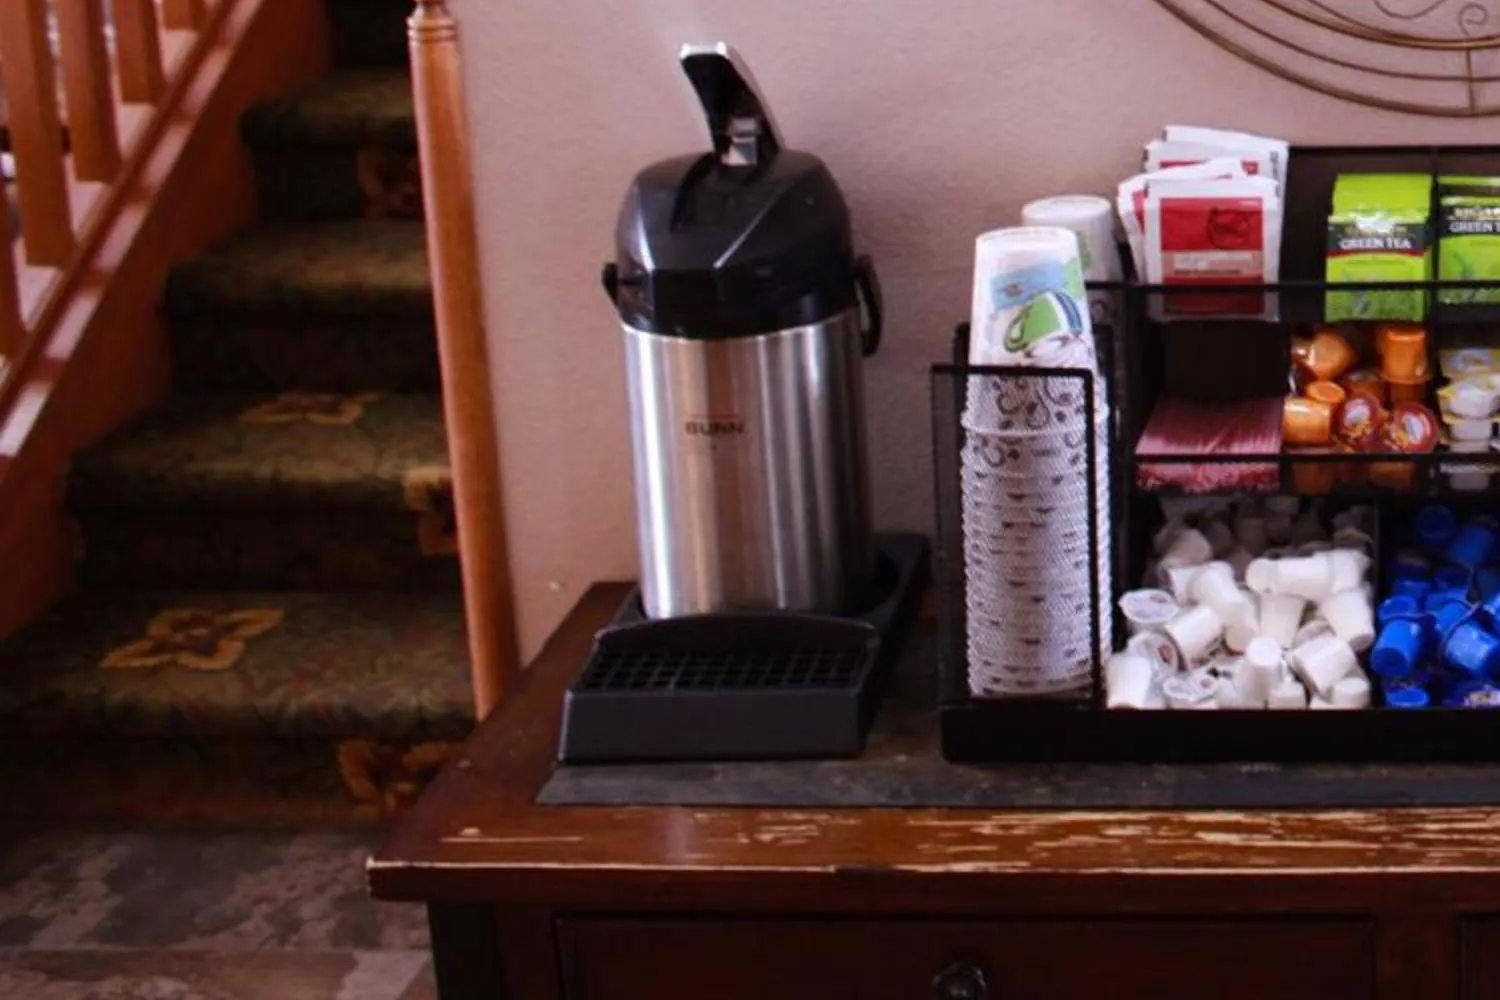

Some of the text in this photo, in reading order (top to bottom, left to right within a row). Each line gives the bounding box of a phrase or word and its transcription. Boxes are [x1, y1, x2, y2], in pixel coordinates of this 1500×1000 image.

[1449, 220, 1493, 233] GREEN
[1339, 236, 1412, 250] GREEN TEA
